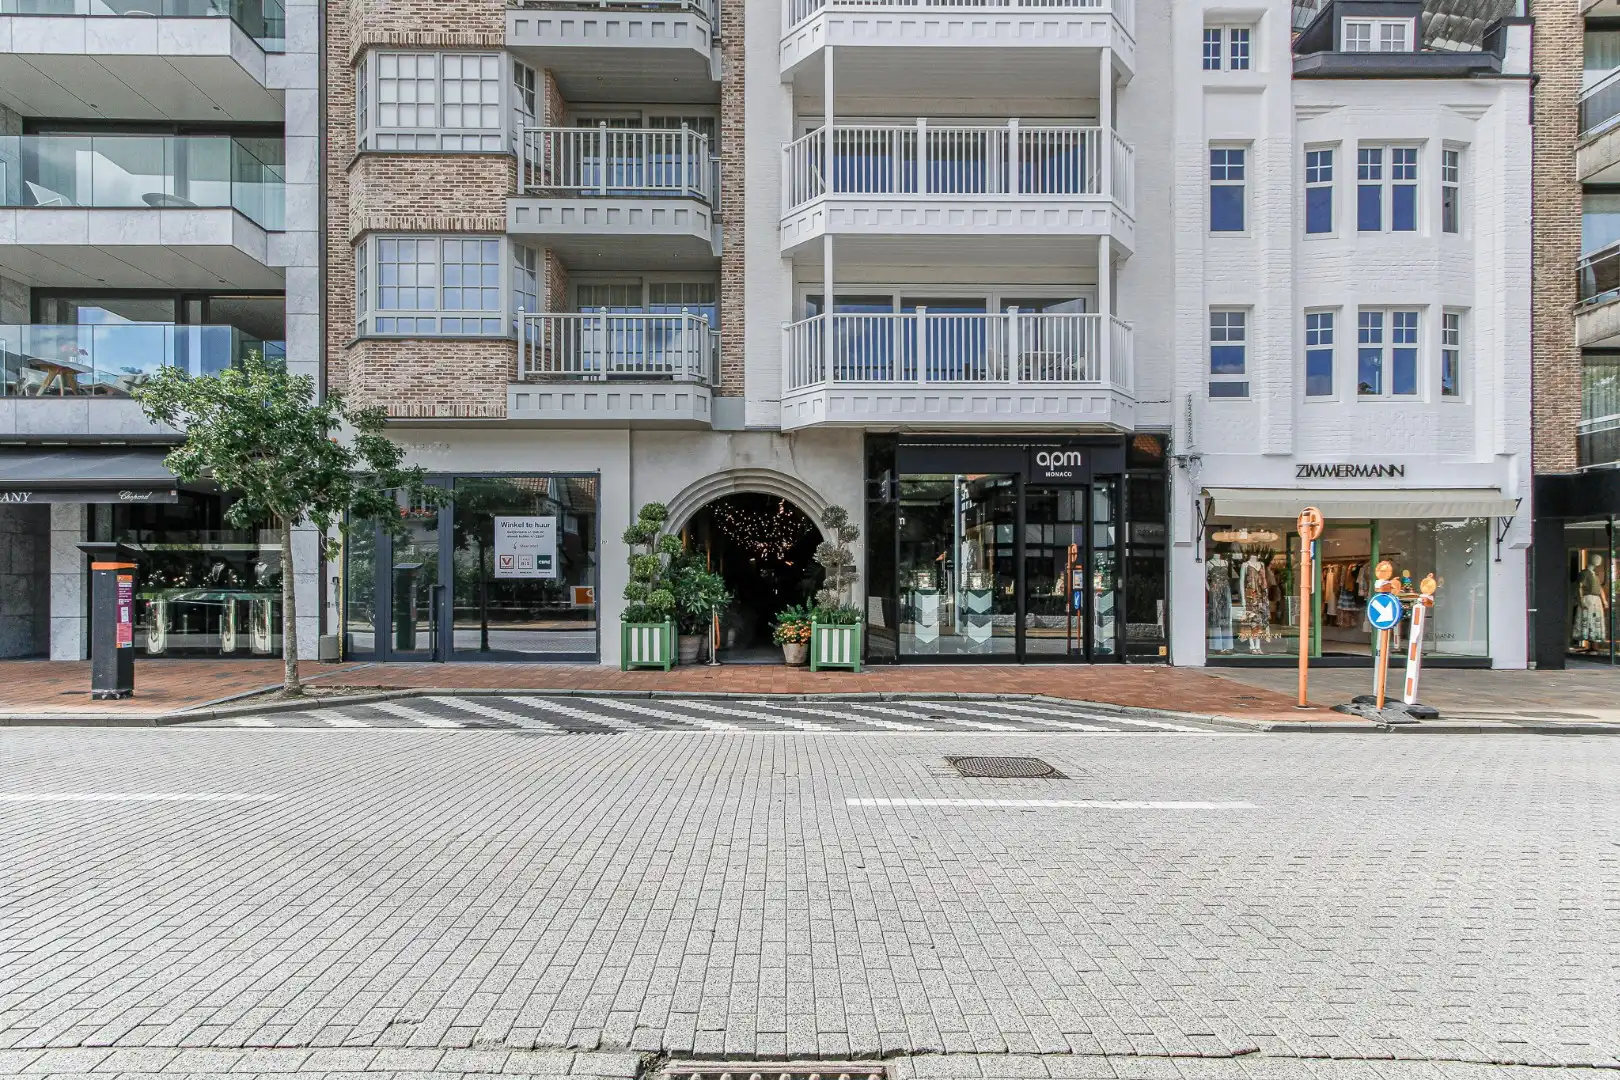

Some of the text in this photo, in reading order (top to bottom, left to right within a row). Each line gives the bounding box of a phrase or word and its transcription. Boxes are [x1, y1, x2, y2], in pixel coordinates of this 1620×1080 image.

[1036, 451, 1081, 471] apm
[1295, 464, 1404, 478] ZIMMERMANN
[0, 490, 152, 502] ANY Chopard
